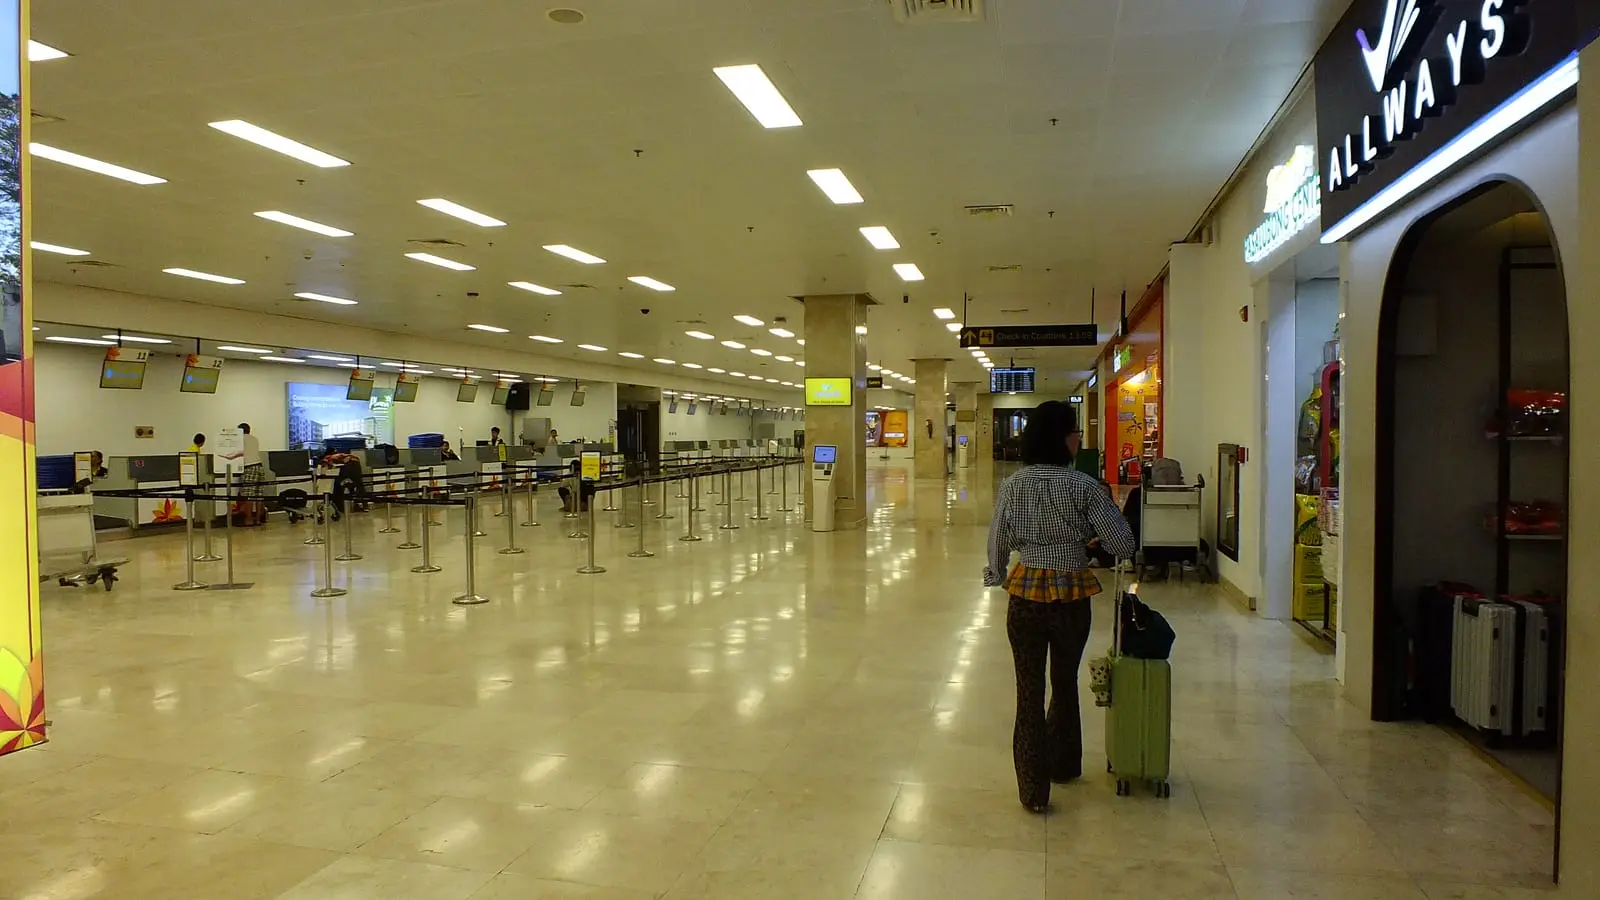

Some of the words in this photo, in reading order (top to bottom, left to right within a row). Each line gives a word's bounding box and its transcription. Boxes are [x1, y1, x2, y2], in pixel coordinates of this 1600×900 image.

[1328, 0, 1505, 192] ALLWAYS
[136, 352, 147, 360] 11
[212, 360, 223, 368] 12
